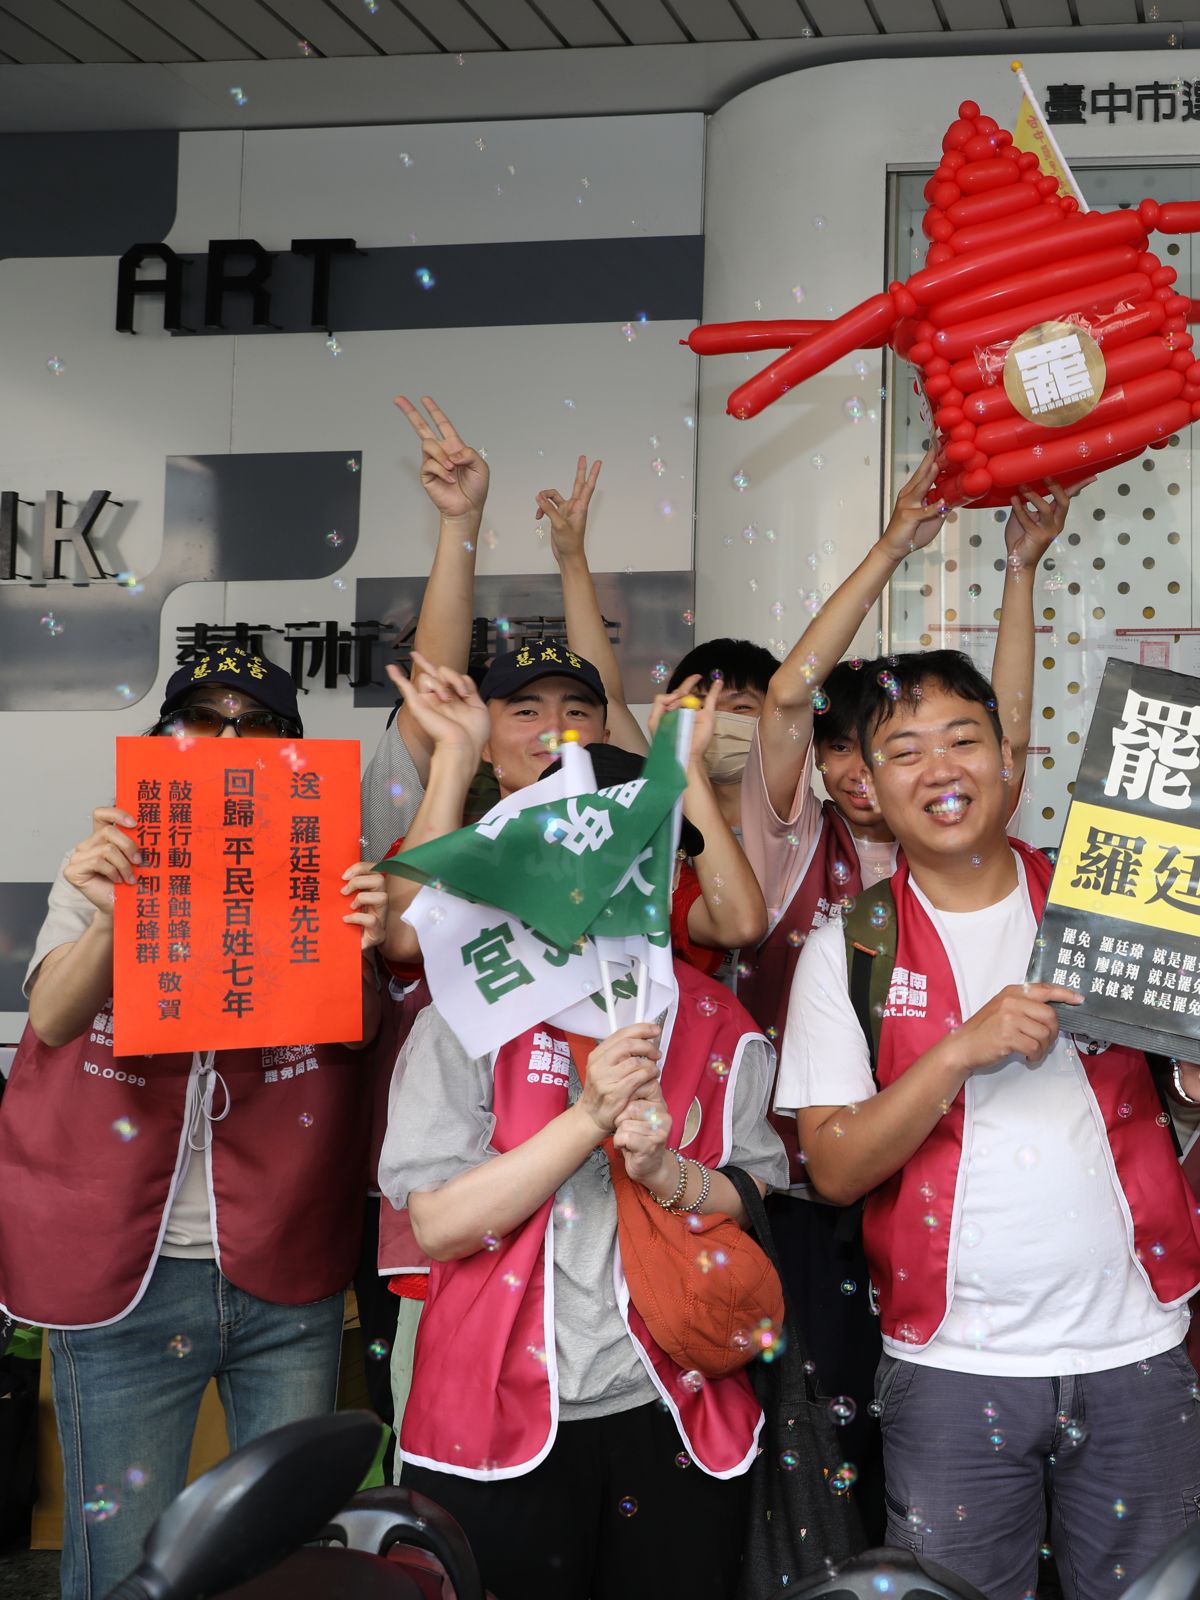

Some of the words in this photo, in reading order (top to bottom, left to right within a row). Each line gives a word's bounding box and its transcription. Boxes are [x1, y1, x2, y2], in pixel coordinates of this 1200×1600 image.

[116, 239, 358, 333] ART
[222, 768, 255, 828] 回歸
[289, 771, 321, 800] 送
[137, 779, 162, 869] 敲羅行動
[168, 780, 192, 869] 敲羅行動
[136, 875, 161, 964] 卸廷蜂群
[289, 815, 321, 964] 羅廷瑋先生
[221, 836, 255, 1018] 平民百姓七年
[1062, 927, 1091, 949] 罷免
[1099, 935, 1144, 960] 羅廷瑋
[891, 966, 928, 990] 東南
[1052, 968, 1081, 989] 罷免
[1090, 976, 1136, 1001] 黃健豪
[1142, 988, 1200, 1017] 就是罷免
[1057, 947, 1086, 969] 罷免
[1094, 956, 1140, 981] 廖偉翔
[158, 971, 182, 1020] 敬賀
